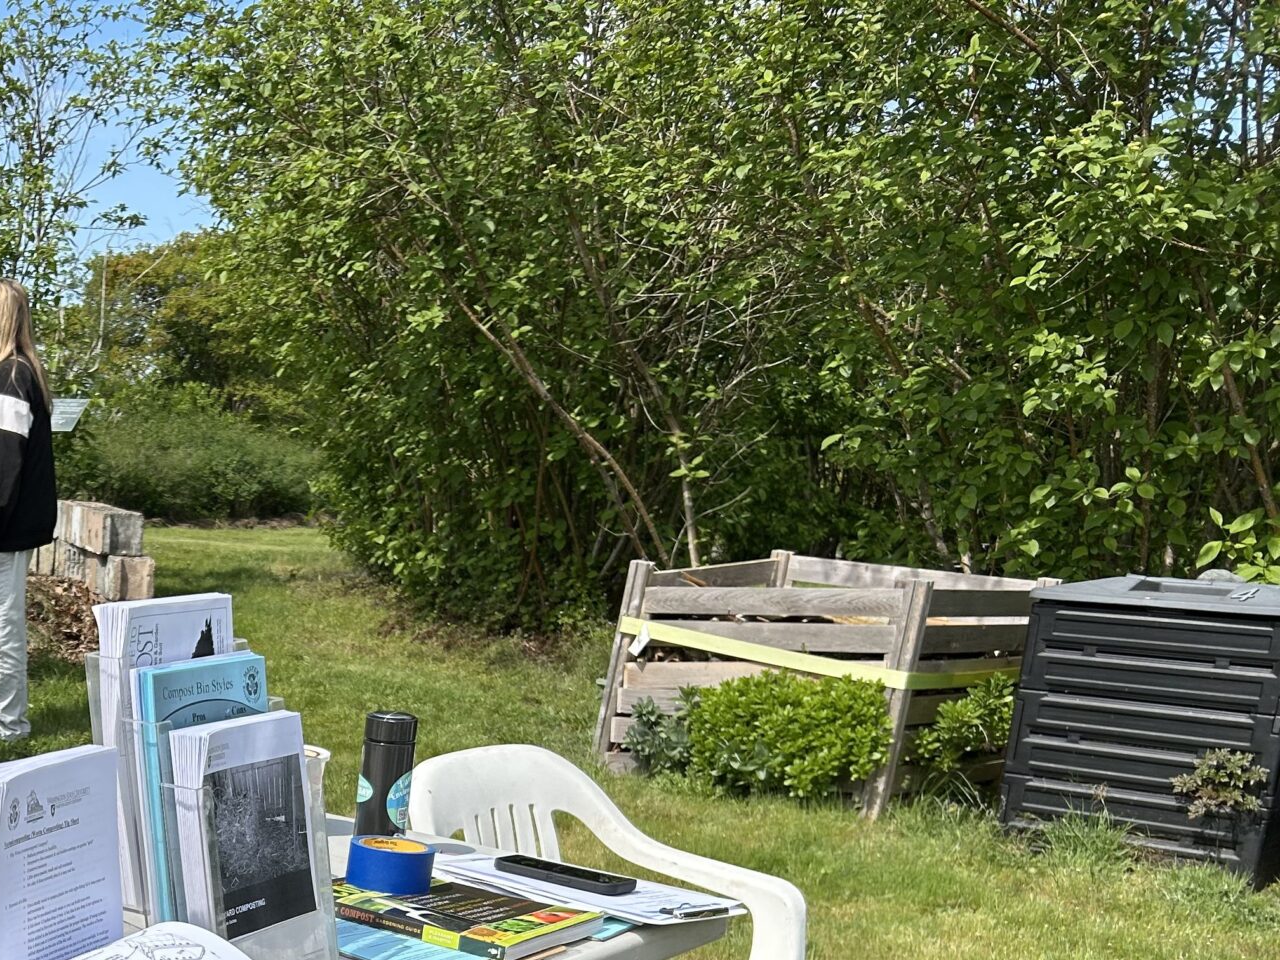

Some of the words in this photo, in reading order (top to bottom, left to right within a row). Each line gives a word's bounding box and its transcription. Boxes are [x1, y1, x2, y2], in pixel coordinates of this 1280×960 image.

[1230, 587, 1260, 602] 4
[162, 686, 194, 701] Compost
[196, 681, 209, 694] Bin
[212, 678, 234, 694] Styles
[192, 713, 206, 722] Pros
[236, 898, 266, 914] COMPOSTING
[340, 907, 375, 922] COMPOST
[376, 918, 405, 930] GARDENING
